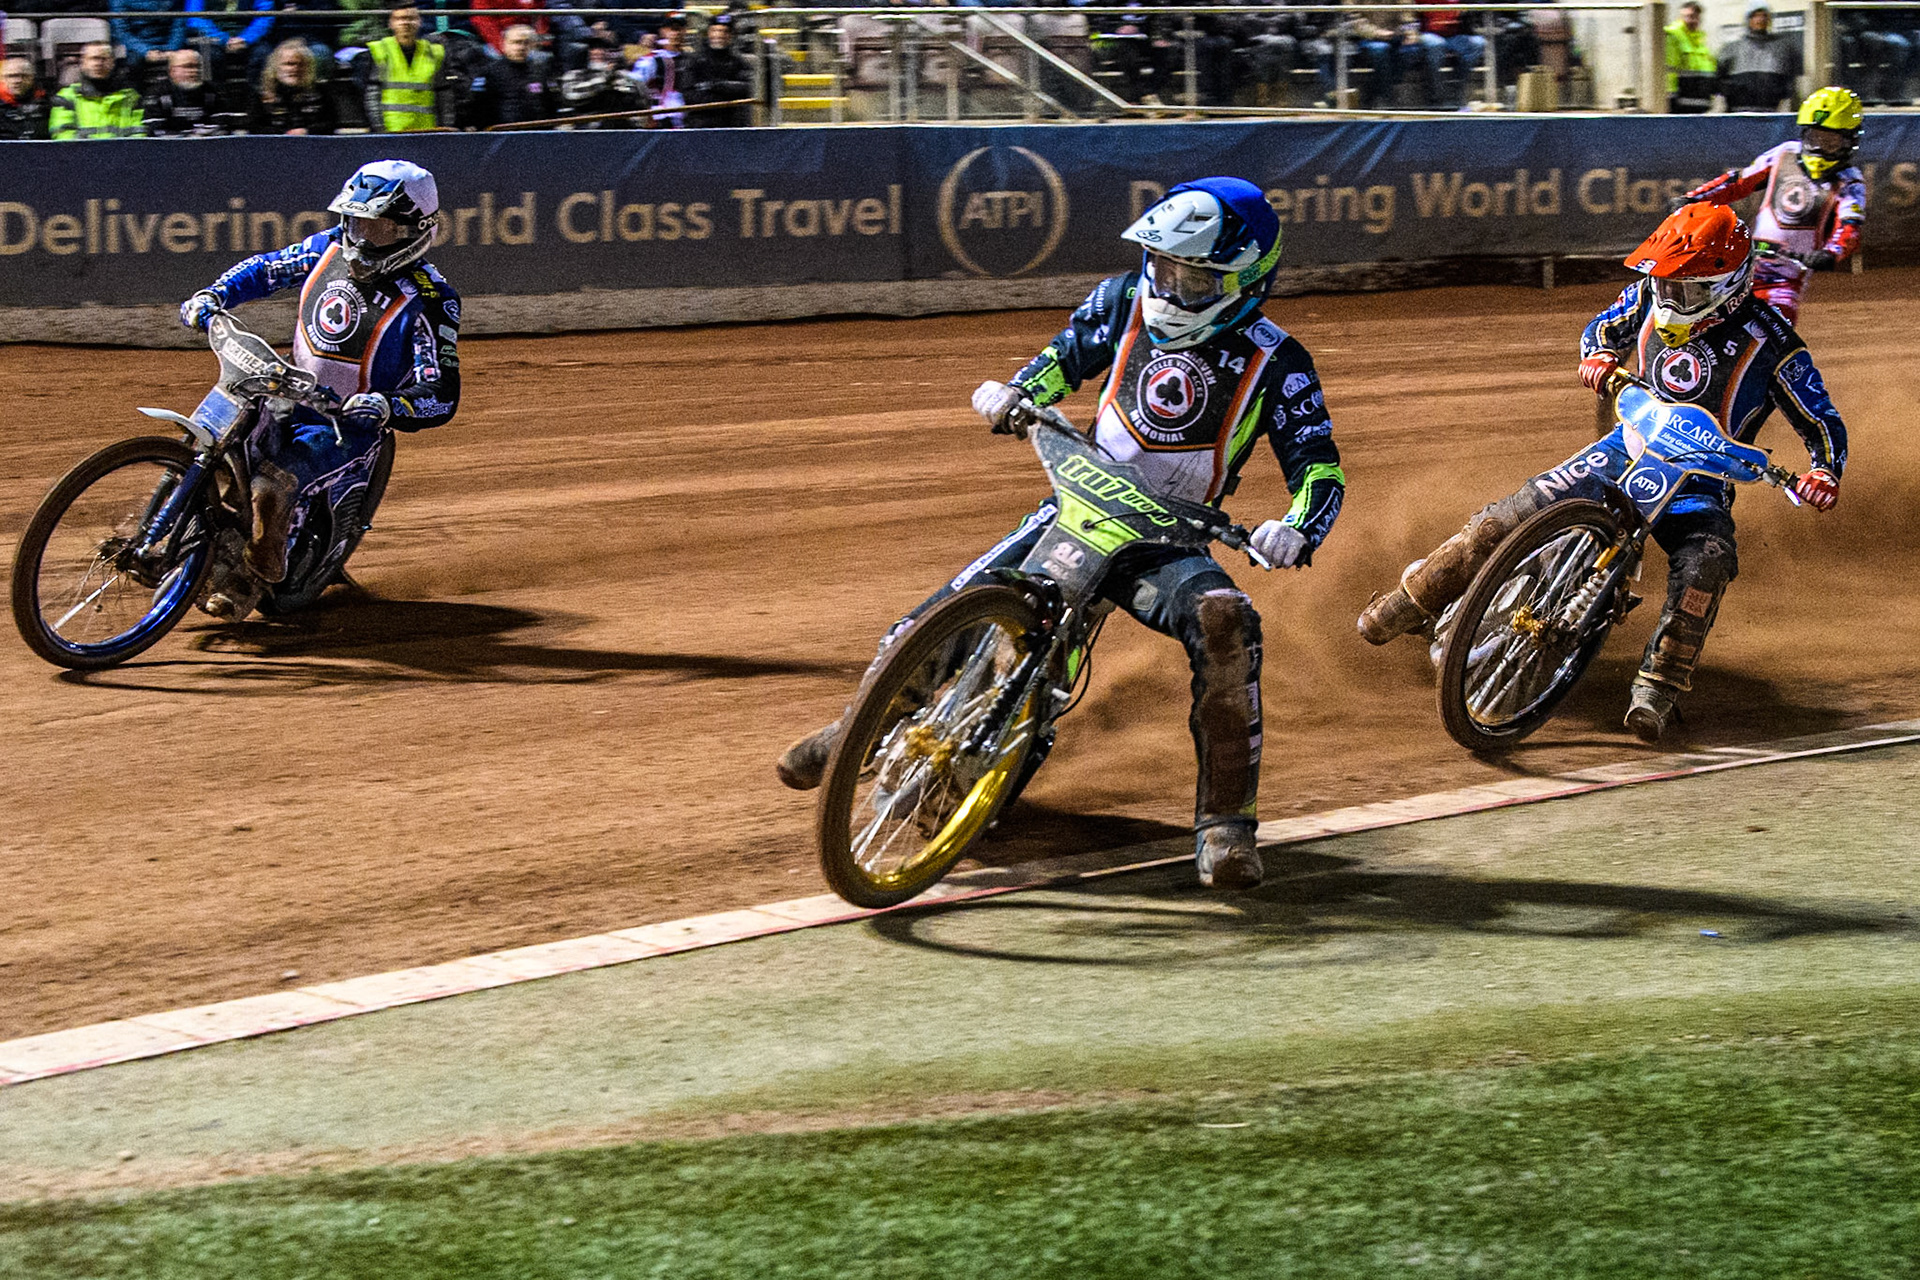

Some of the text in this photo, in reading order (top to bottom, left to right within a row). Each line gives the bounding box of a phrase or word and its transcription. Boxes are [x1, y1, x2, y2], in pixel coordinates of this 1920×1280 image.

[556, 191, 713, 243] Class
[731, 184, 902, 237] Travel
[959, 190, 1044, 229] ATPI
[1130, 174, 1397, 234] Dering
[1410, 168, 1563, 217] World
[372, 290, 391, 310] 11
[1218, 349, 1246, 375] 14
[1698, 340, 1718, 366] RAVEN
[1723, 339, 1738, 356] 5
[1147, 359, 1203, 398] BELLE VUE ACES
[1129, 409, 1186, 442] MEMORIAL
[1535, 451, 1609, 501] Nice
[1631, 475, 1660, 495] ATPI
